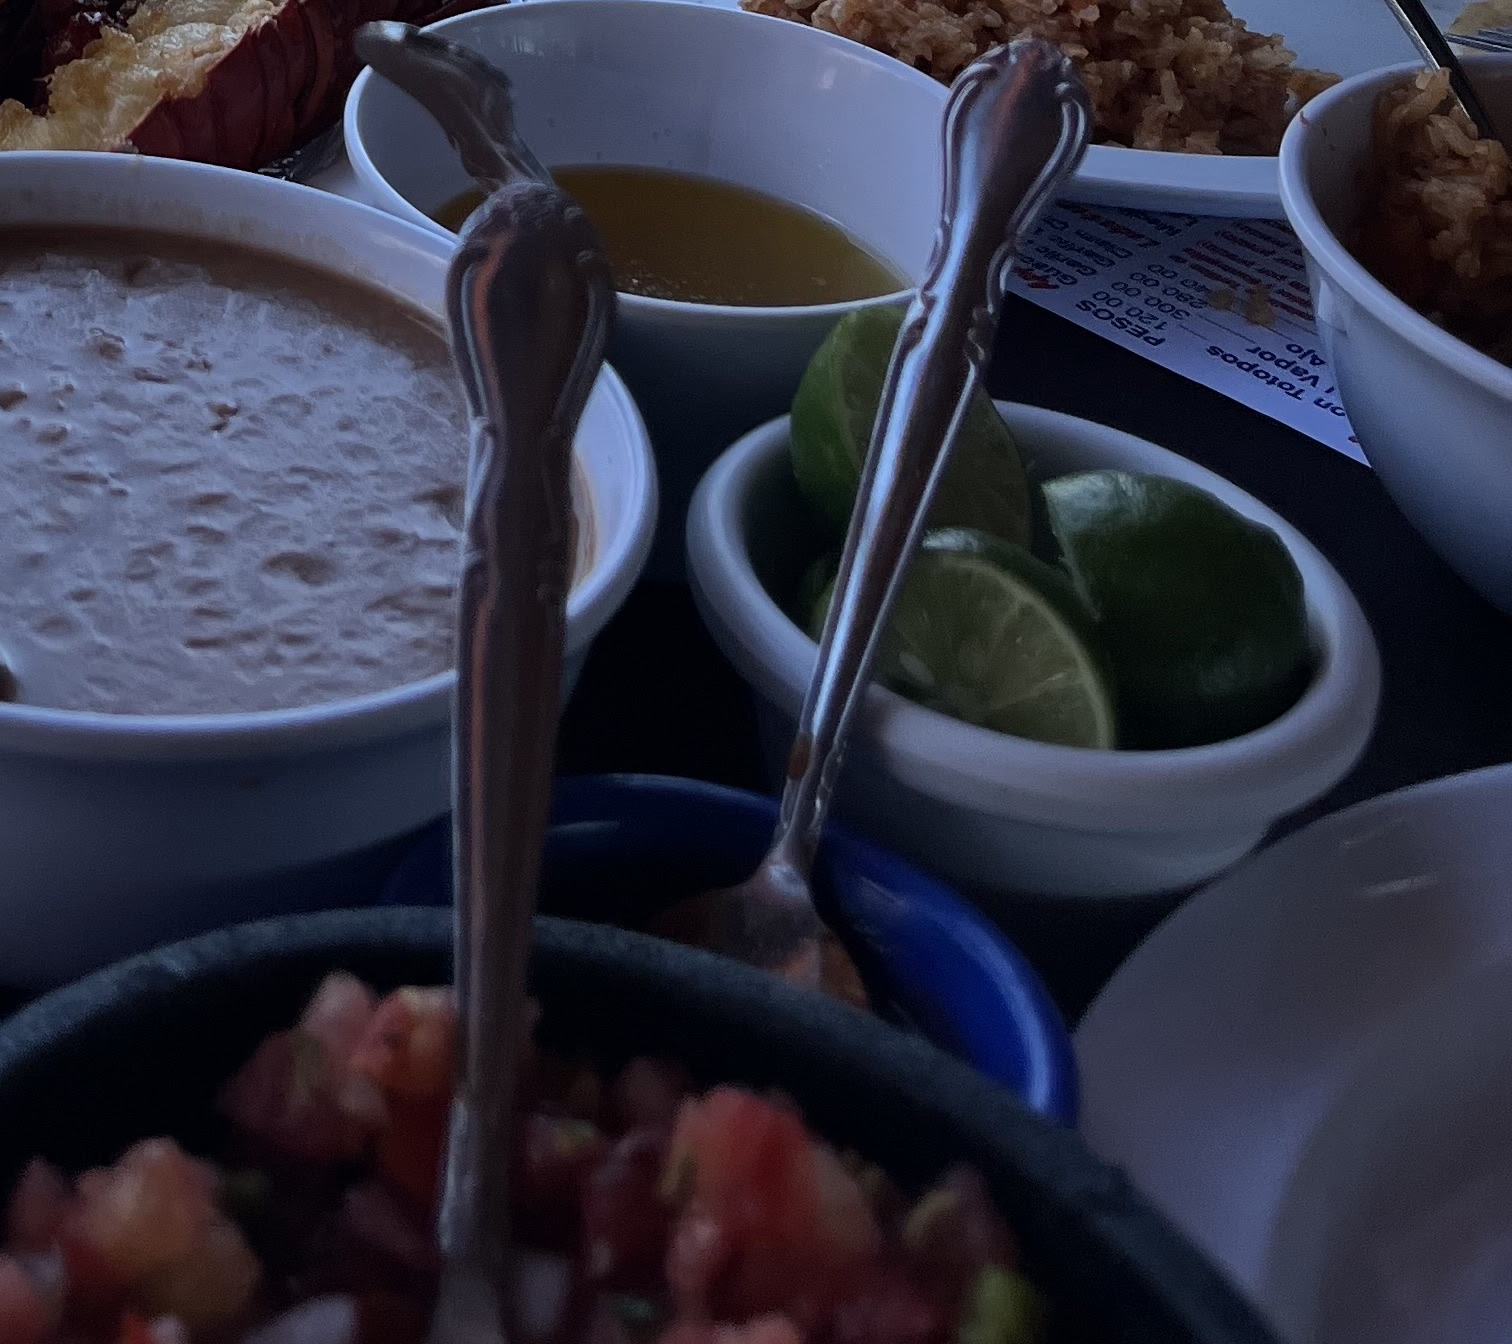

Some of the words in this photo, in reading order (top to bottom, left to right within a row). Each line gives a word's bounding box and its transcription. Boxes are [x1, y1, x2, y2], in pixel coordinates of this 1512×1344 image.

[1075, 300, 1166, 346] PESOS
[1206, 345, 1306, 401] Totopos
[1245, 346, 1320, 388] Vapor
[1285, 343, 1327, 367] Ajo
